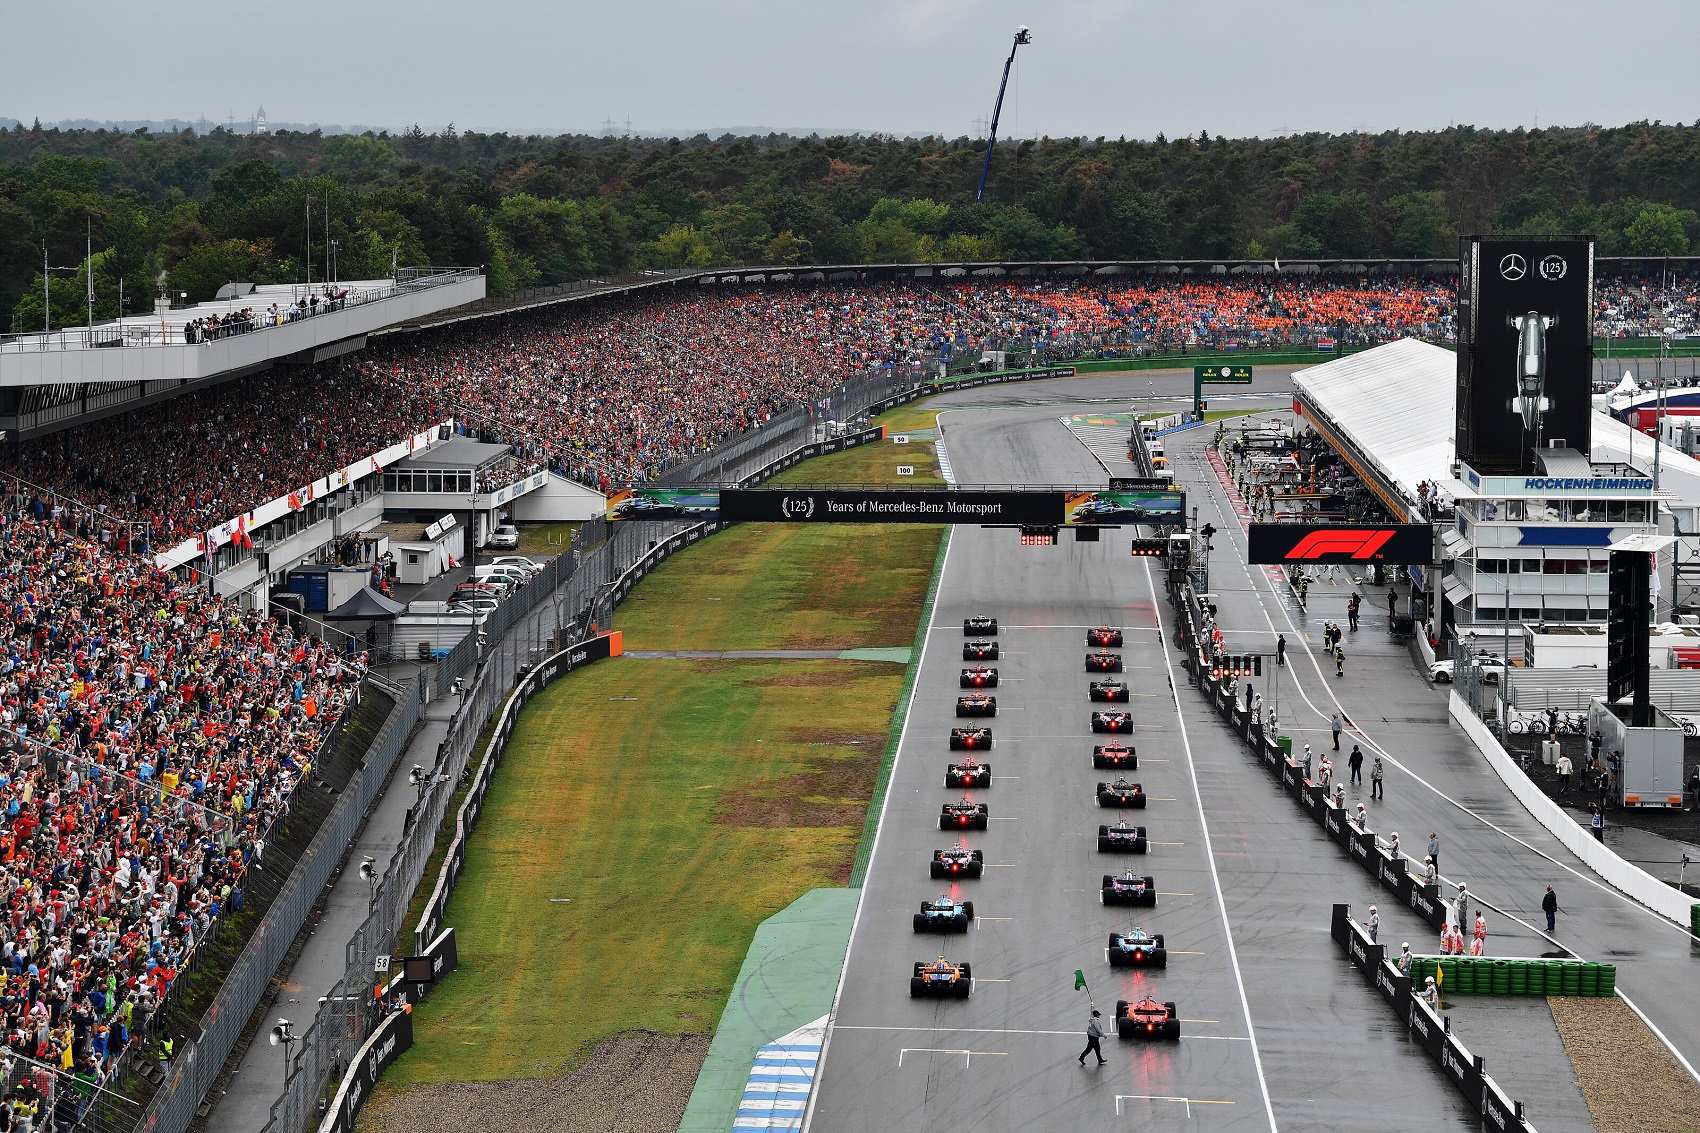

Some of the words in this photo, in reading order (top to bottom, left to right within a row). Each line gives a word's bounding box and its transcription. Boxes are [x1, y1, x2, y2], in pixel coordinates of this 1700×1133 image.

[1545, 262, 1561, 273] 125
[1524, 478, 1654, 490] HOCKENHEIMRING
[790, 501, 807, 512] 125
[827, 501, 854, 512] Years
[856, 501, 867, 512] of
[869, 501, 944, 513] Mercedes-Benz
[947, 501, 1002, 515] Motorsport
[1283, 529, 1397, 559] F1
[376, 958, 388, 968] 58
